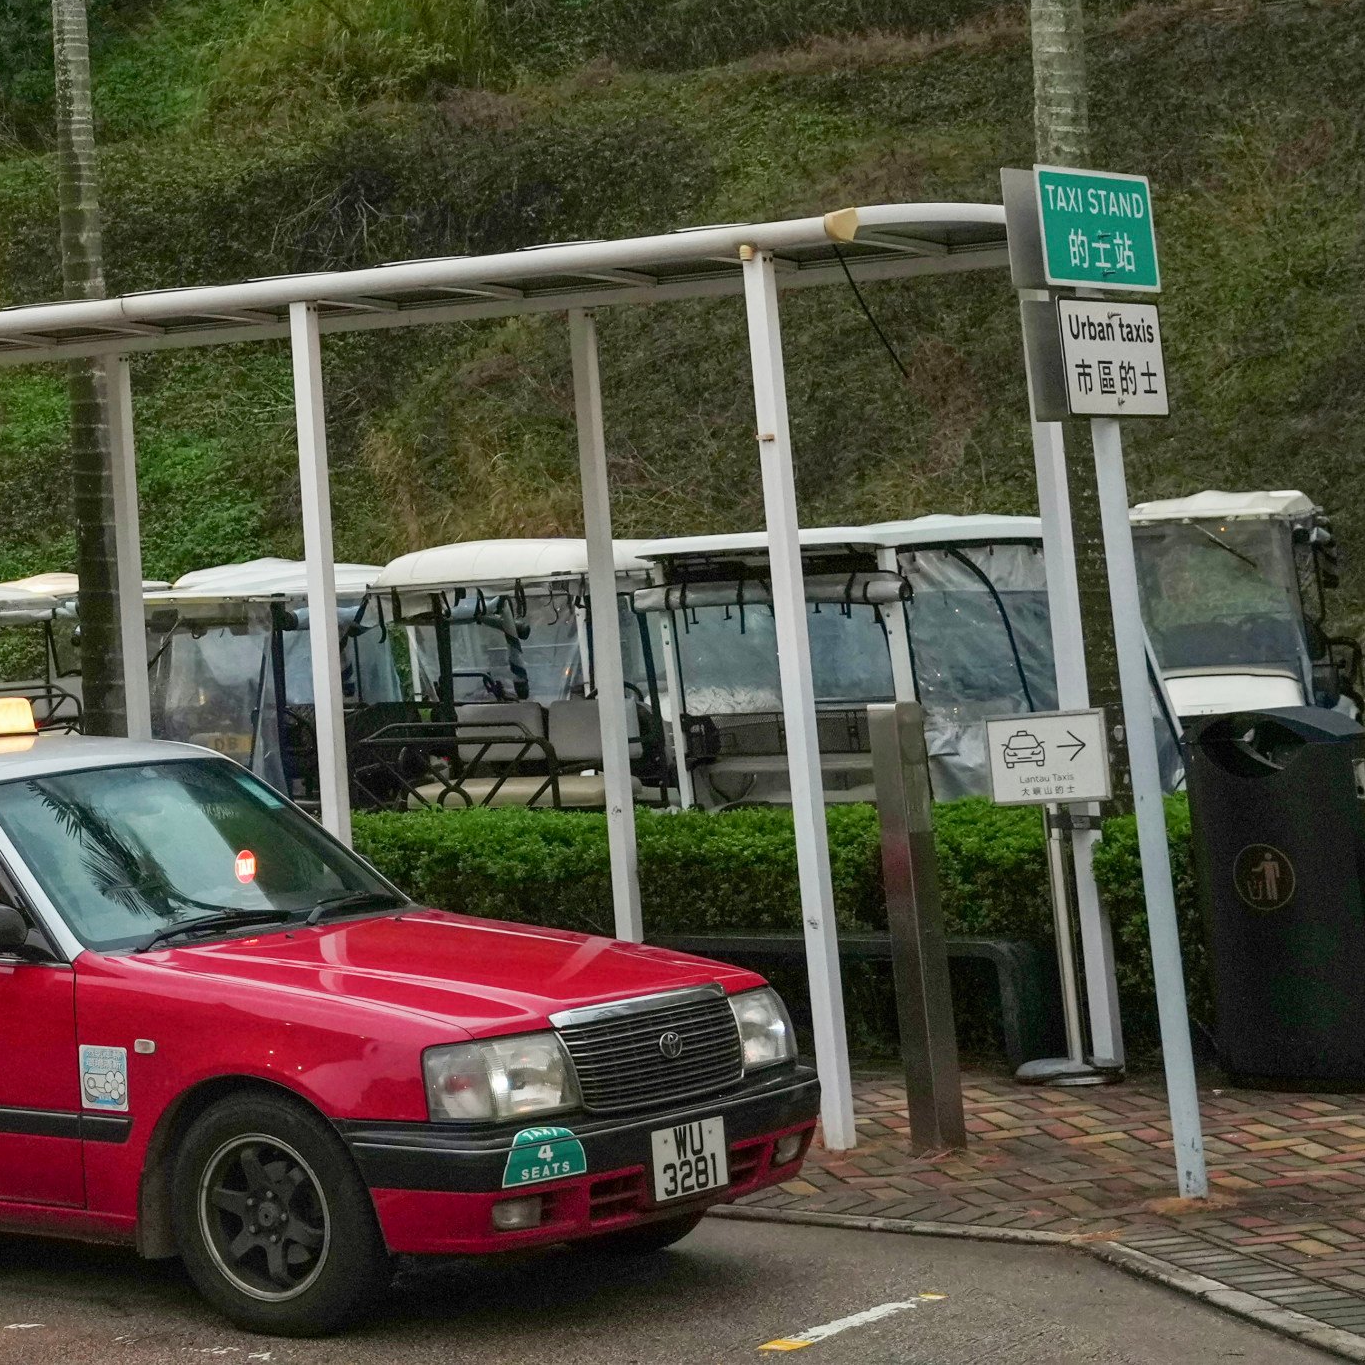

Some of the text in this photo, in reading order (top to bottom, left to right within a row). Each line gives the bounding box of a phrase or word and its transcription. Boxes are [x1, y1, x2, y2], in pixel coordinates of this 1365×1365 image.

[1045, 185, 1144, 218] TAXI STAND
[1068, 228, 1136, 272] 的士站
[1068, 313, 1155, 343] Urban taxis
[1075, 359, 1158, 396] 市區的士
[1019, 774, 1074, 784] Lantau Taxis
[236, 858, 255, 876] TAXI
[538, 1144, 554, 1162] 4
[673, 1122, 704, 1160] WU
[521, 1161, 570, 1181] SEATS
[663, 1152, 719, 1197] 3281
